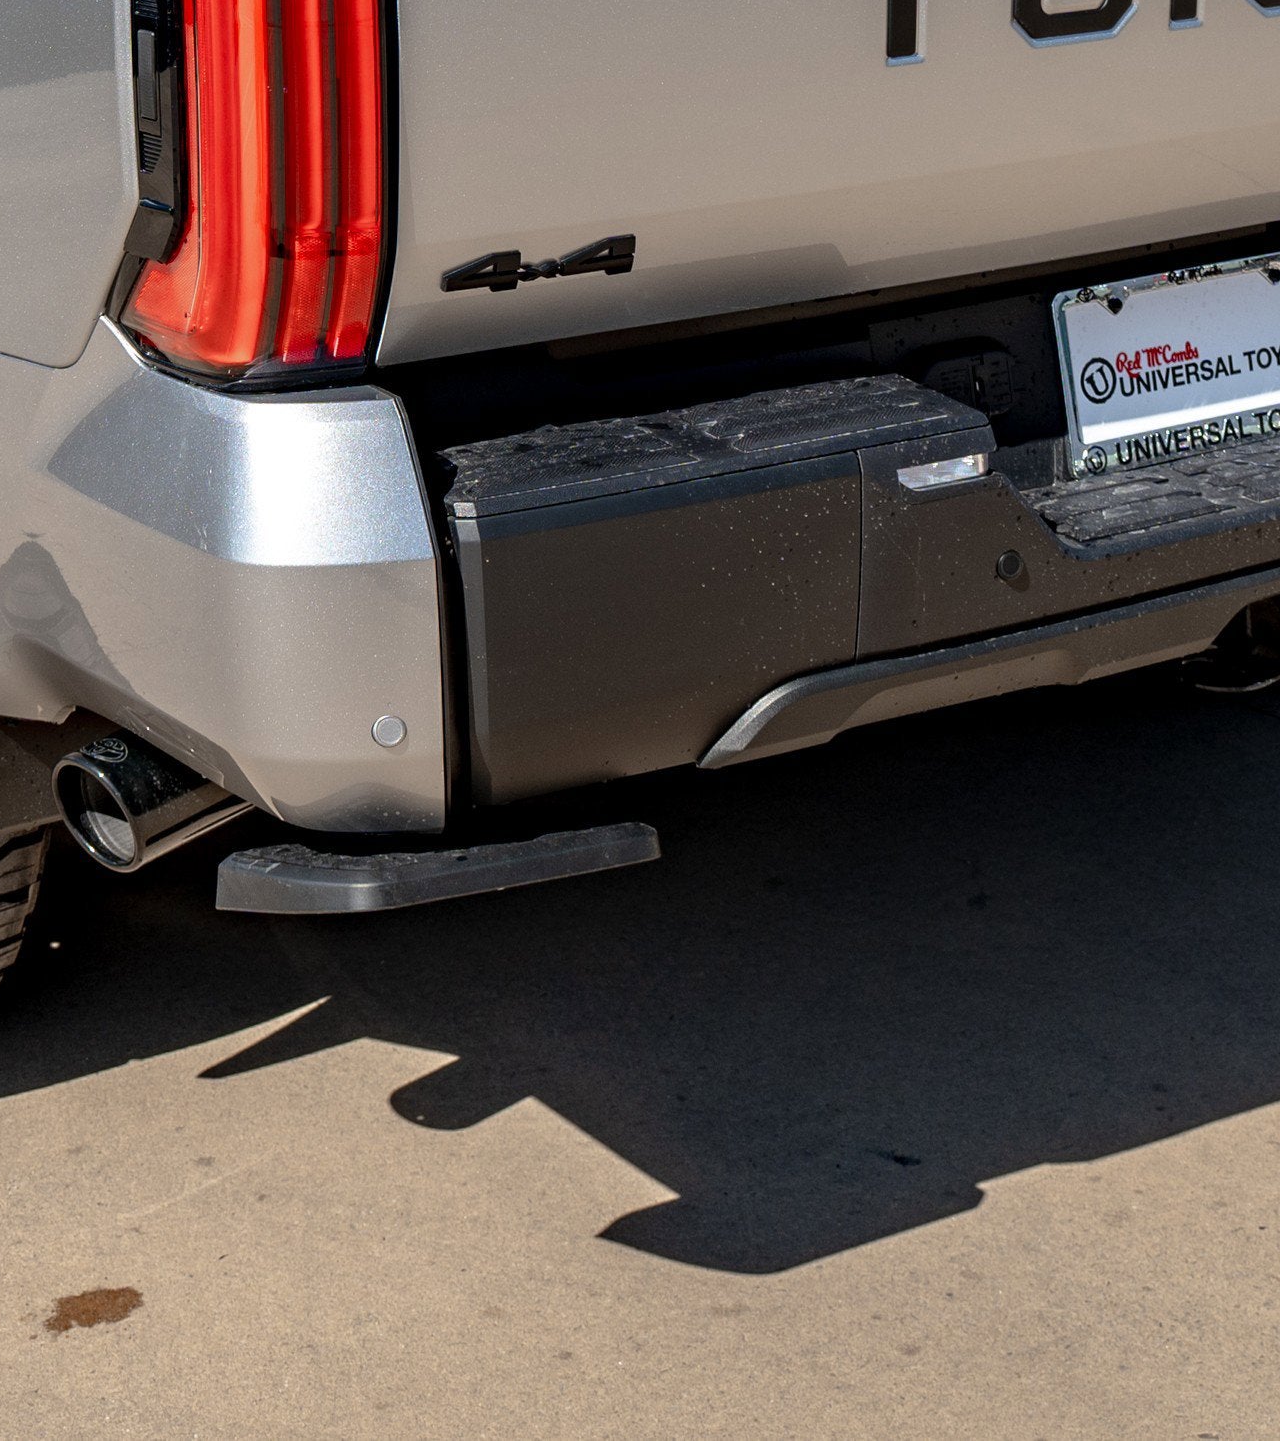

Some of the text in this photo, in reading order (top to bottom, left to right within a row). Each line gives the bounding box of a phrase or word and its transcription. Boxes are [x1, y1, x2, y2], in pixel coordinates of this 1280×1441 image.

[1116, 351, 1142, 378] Red
[1120, 355, 1241, 397] UNIVERSAL
[1116, 416, 1252, 465] UNIVERSAL
